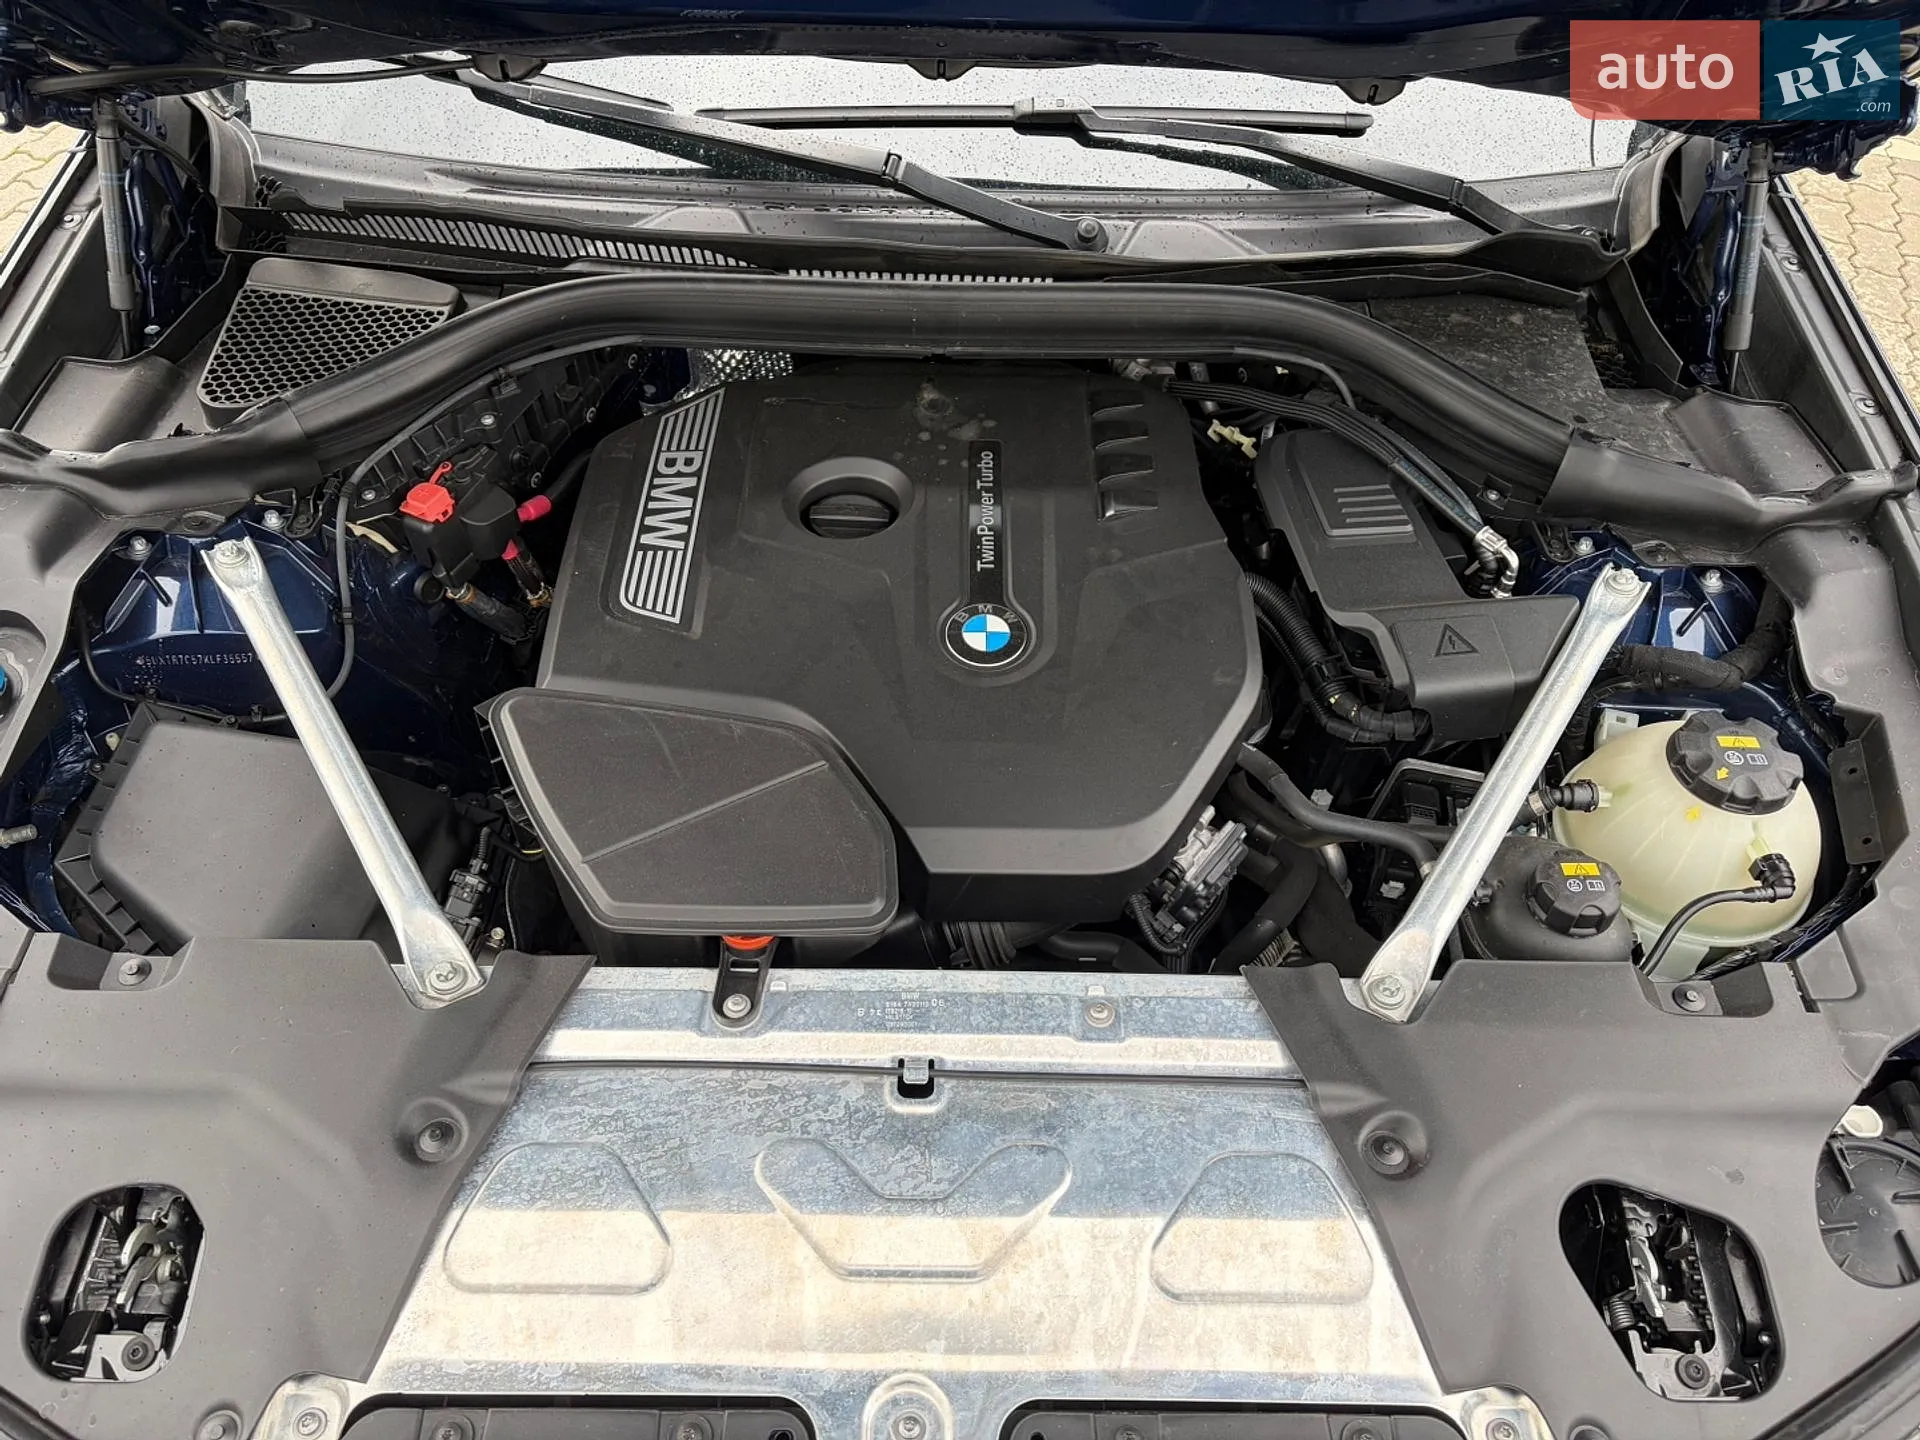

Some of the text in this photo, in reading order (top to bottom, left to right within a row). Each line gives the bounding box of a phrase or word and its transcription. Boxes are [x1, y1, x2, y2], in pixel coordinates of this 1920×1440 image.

[640, 451, 704, 550] BMW
[976, 450, 996, 573] TwinPower Turbo
[953, 604, 1019, 626] BMW
